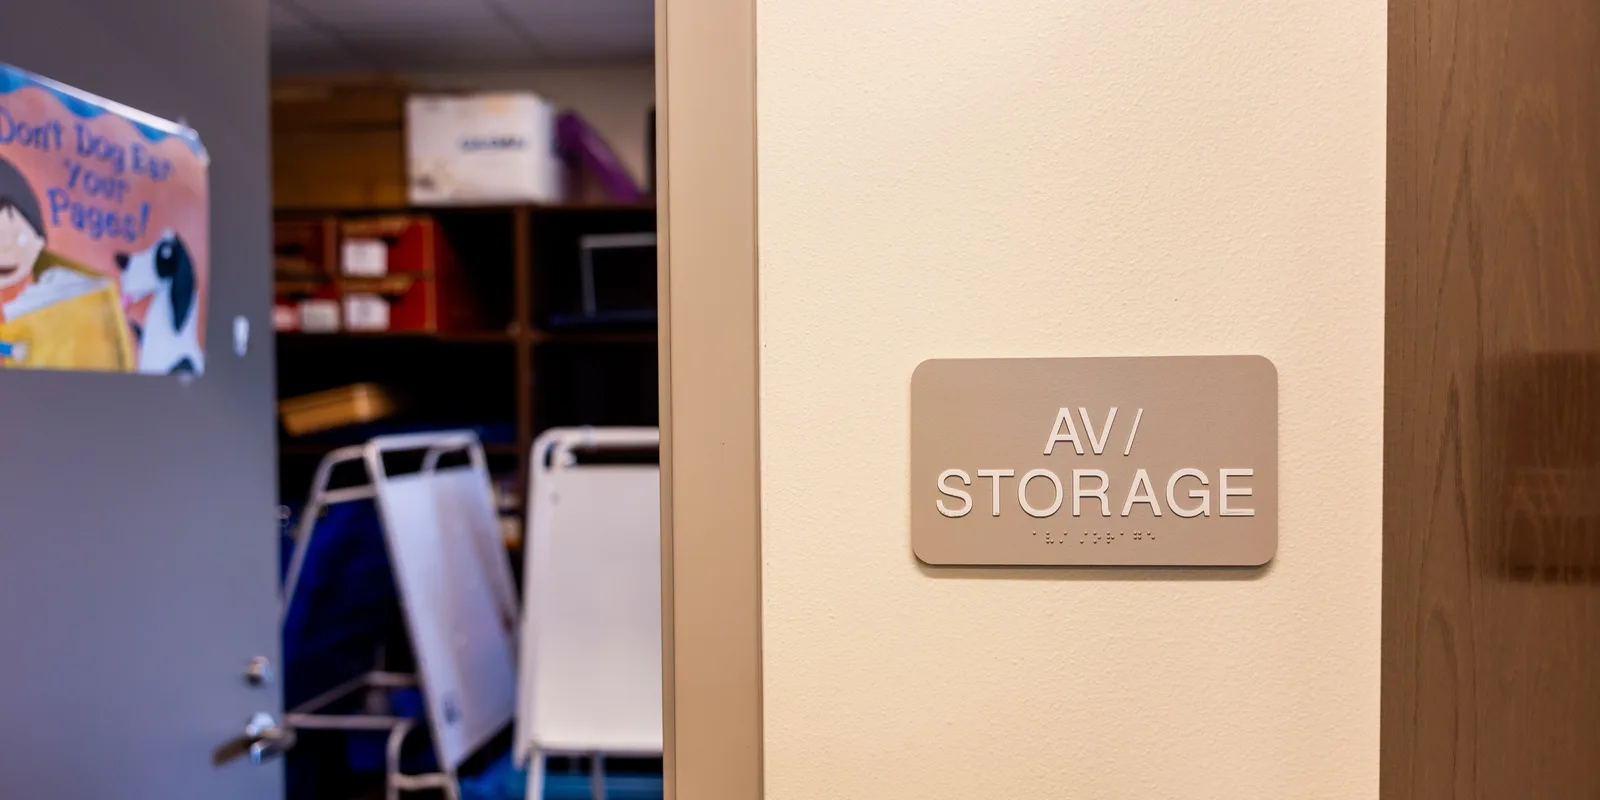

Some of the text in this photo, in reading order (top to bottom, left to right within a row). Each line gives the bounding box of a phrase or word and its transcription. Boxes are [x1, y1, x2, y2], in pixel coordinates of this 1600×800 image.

[75, 122, 125, 175] Dog
[63, 158, 128, 203] Your
[47, 187, 150, 242] Pages!
[1043, 407, 1144, 456] AV/
[936, 468, 1255, 519] STORAGE
